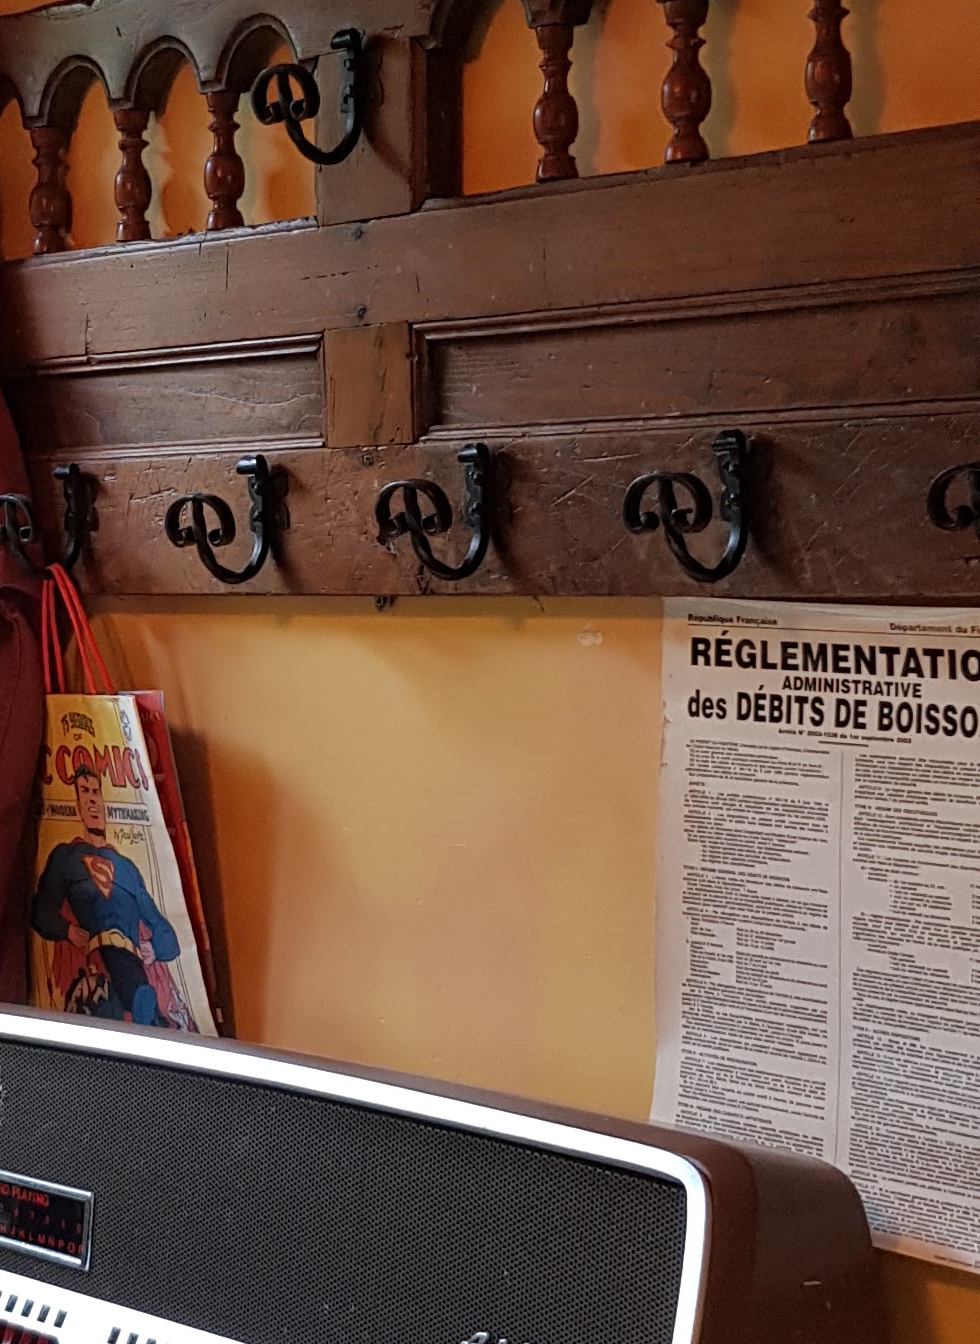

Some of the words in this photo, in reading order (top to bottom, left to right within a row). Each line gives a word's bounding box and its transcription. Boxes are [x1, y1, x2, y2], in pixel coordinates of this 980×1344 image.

[688, 614, 733, 625] République
[737, 616, 777, 627] Française
[889, 622, 951, 634] Département
[955, 625, 967, 633] du
[690, 630, 980, 681] RÉGLEMENTATIO
[782, 676, 921, 698] ADMINISTRATIVE
[688, 689, 726, 719] des
[737, 685, 824, 727] DÉBITS
[835, 698, 867, 729] DE
[11, 1185, 50, 1207] PLAYING
